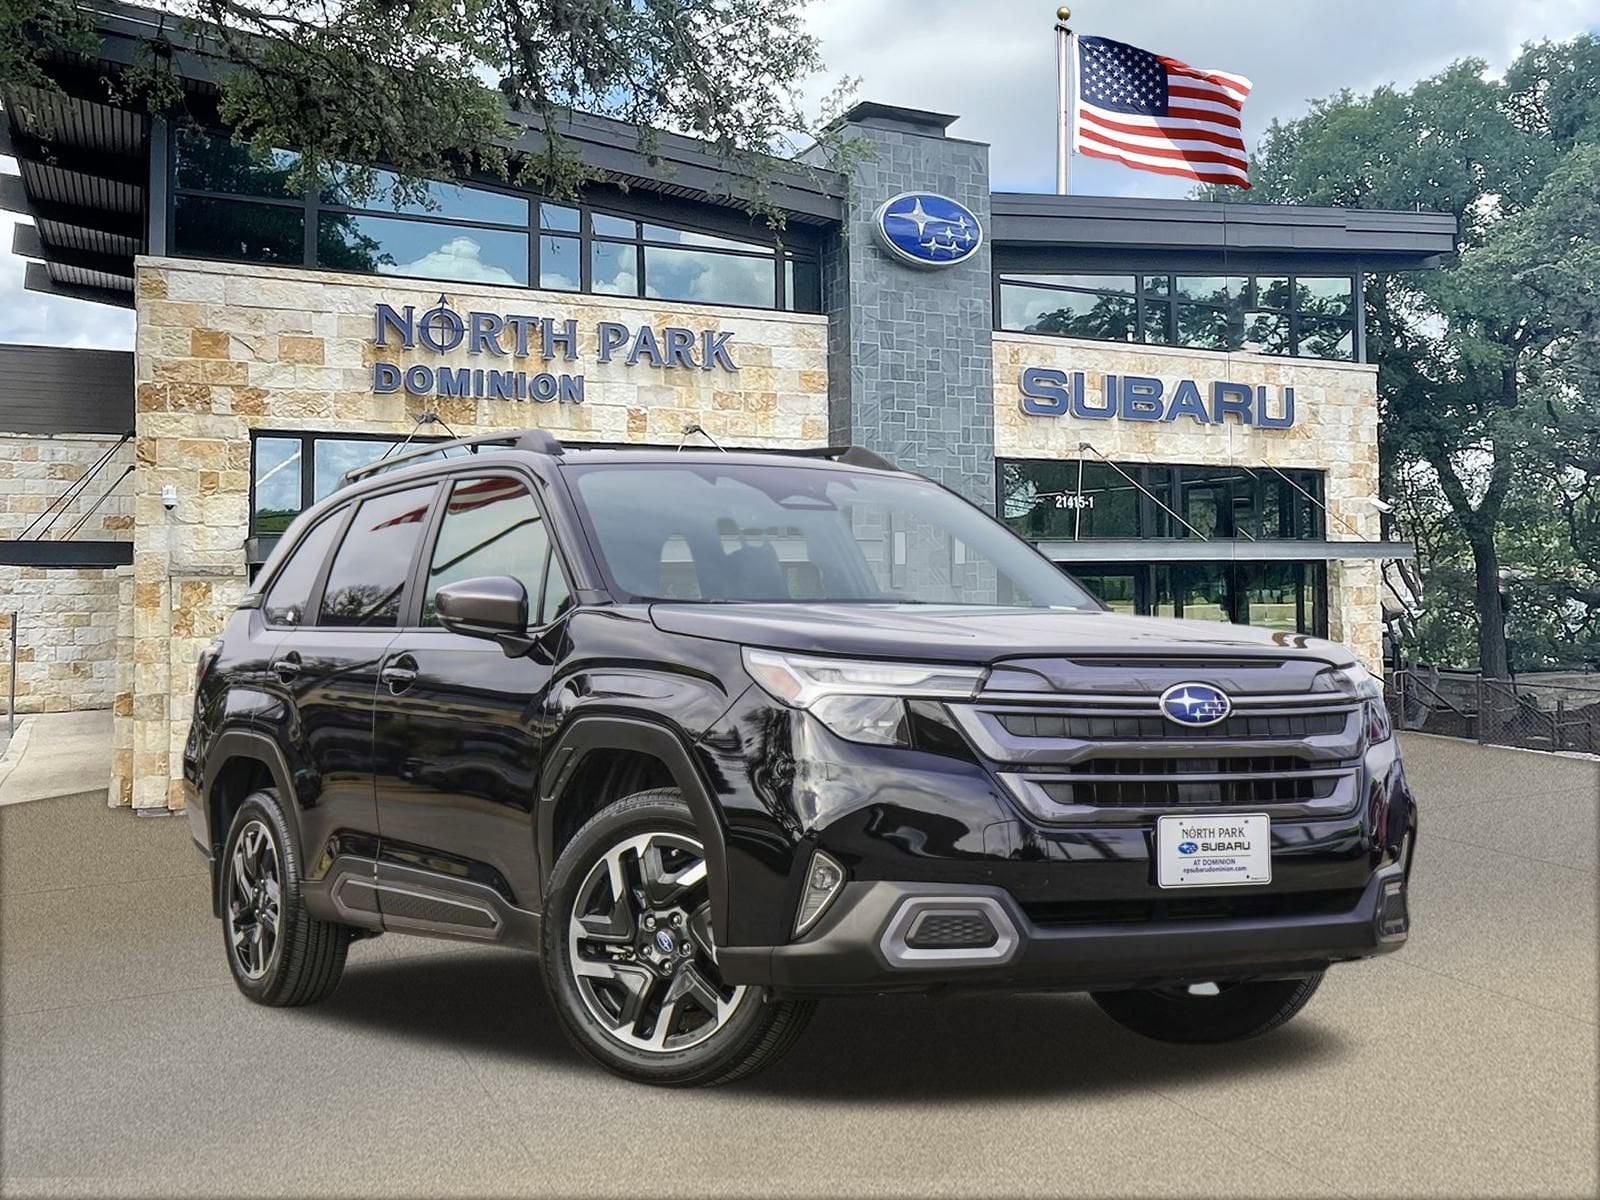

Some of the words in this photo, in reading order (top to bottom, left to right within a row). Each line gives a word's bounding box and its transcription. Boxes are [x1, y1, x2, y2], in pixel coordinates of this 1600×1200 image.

[374, 302, 579, 361] NORTH
[597, 321, 742, 373] PARK
[373, 361, 585, 404] DOMINION
[1019, 367, 1295, 430] SUBARU
[1055, 495, 1094, 509] 21415-1
[1182, 827, 1215, 839] NORTH
[1218, 827, 1245, 838] PARK
[1201, 842, 1251, 851] SUBARU
[1203, 858, 1236, 866] DOMINION
